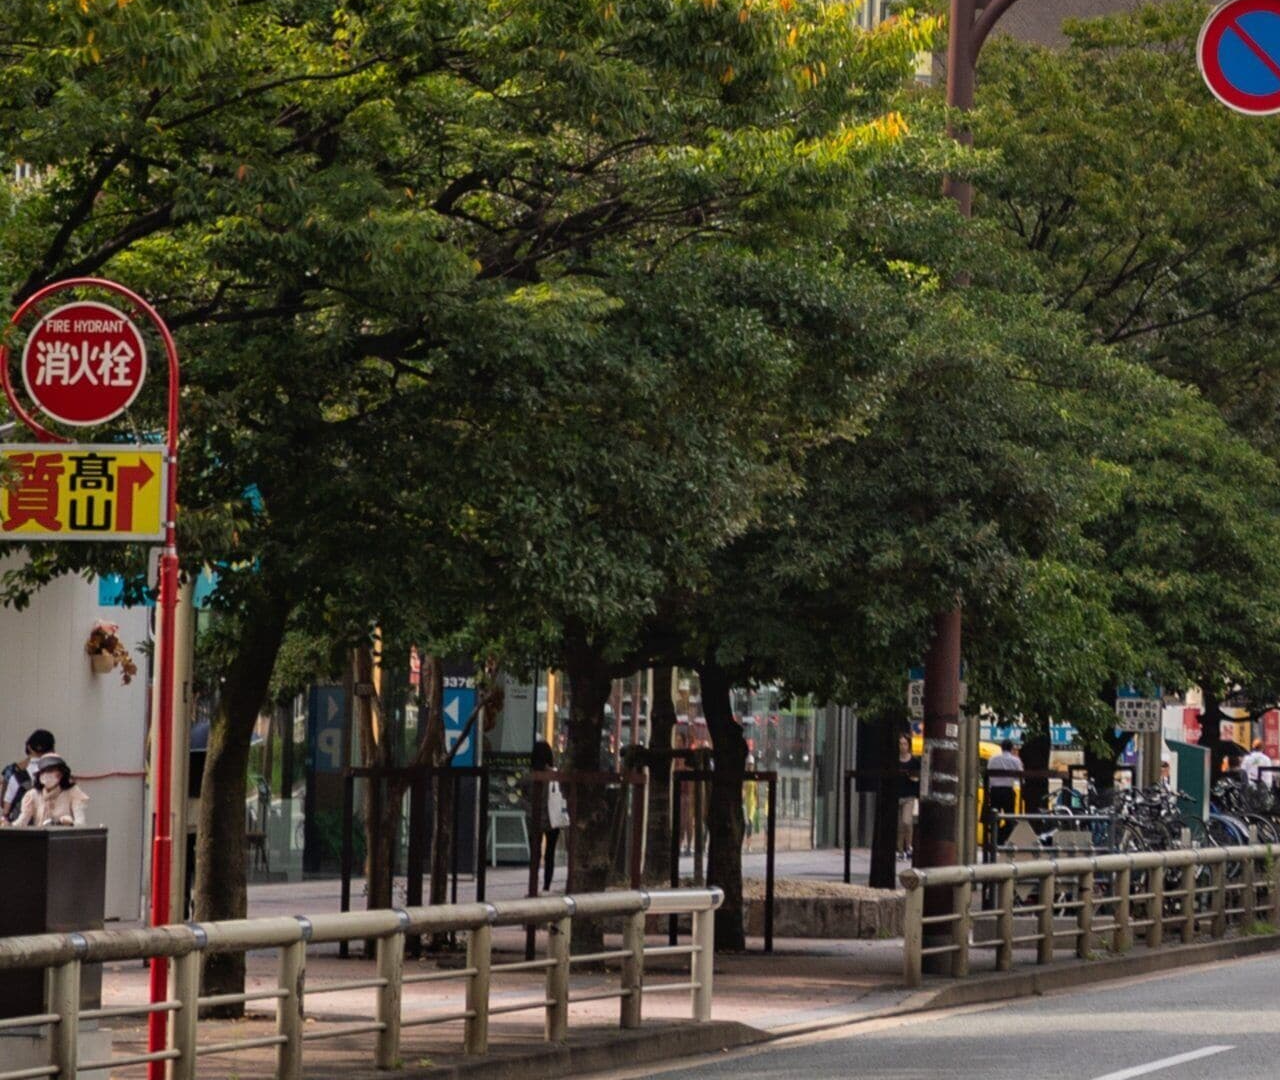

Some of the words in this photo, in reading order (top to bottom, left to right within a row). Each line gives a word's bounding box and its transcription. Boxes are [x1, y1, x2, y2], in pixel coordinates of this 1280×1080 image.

[46, 321, 71, 333] FIRE
[74, 320, 125, 333] HYDRANT
[35, 340, 134, 387] 消火栓
